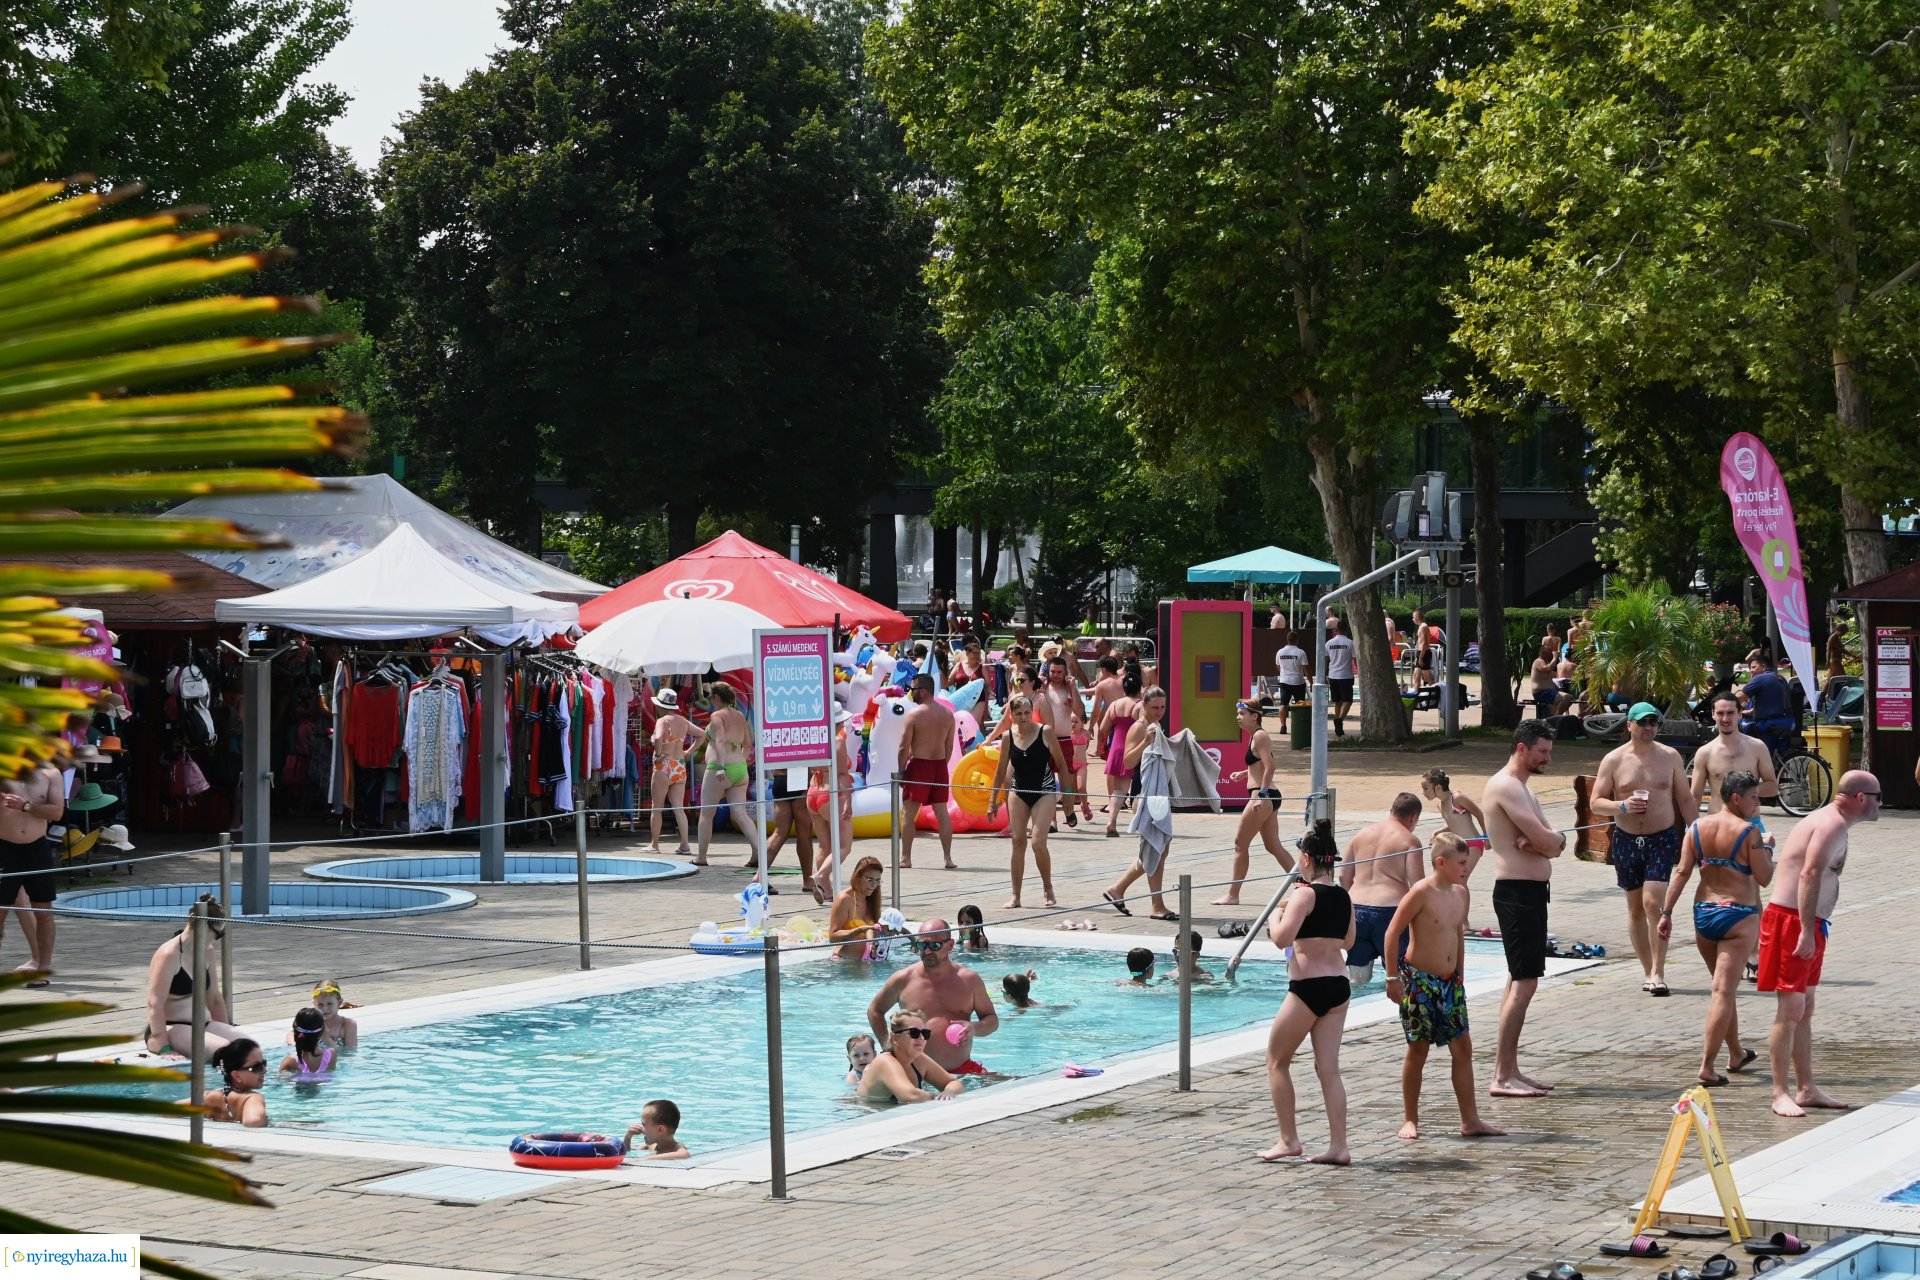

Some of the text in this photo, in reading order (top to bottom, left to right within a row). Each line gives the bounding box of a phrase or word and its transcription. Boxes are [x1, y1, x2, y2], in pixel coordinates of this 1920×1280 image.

[766, 641, 818, 653] 5. SZÁMÚ MEDENCE
[768, 664, 819, 681] VÍZMÉLYSÉG
[783, 701, 807, 718] 0,9 m
